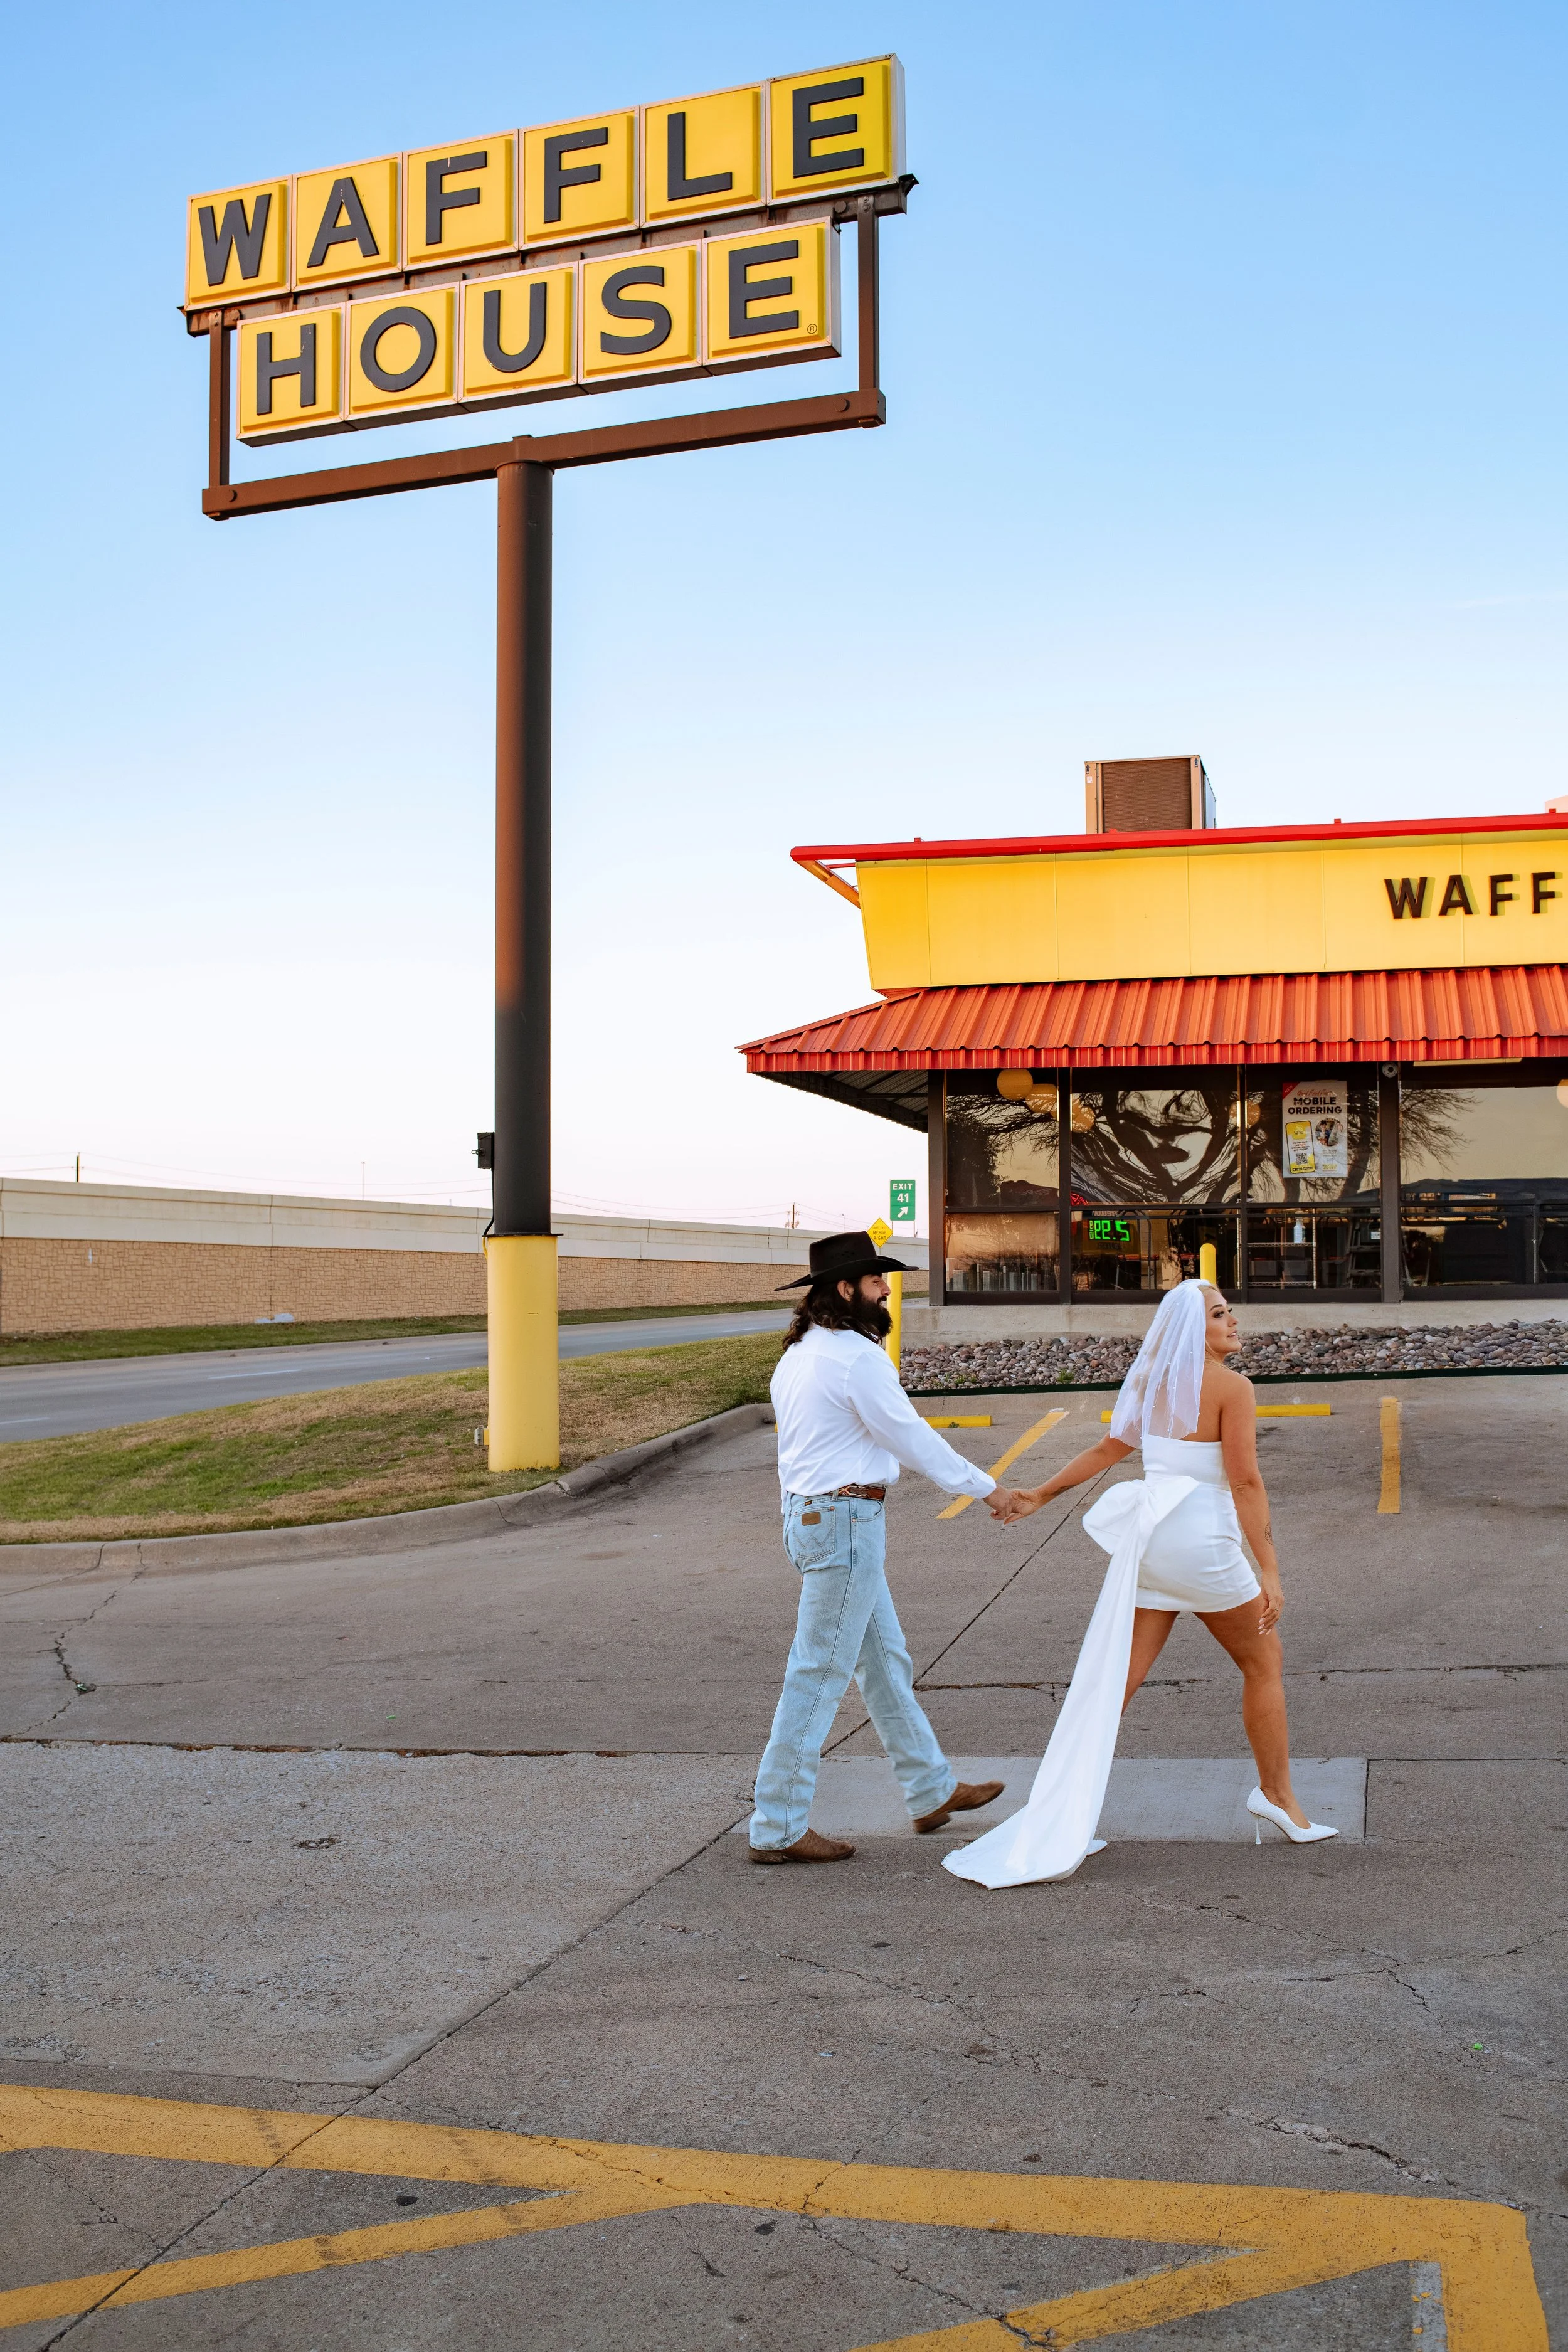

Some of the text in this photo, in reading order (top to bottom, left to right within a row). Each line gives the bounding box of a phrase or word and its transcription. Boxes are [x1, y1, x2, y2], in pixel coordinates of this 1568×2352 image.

[198, 77, 864, 287] WAFFLE
[256, 239, 800, 415] HOUSE
[1293, 1097, 1337, 1105] MOBILE
[897, 1193, 909, 1203] 41
